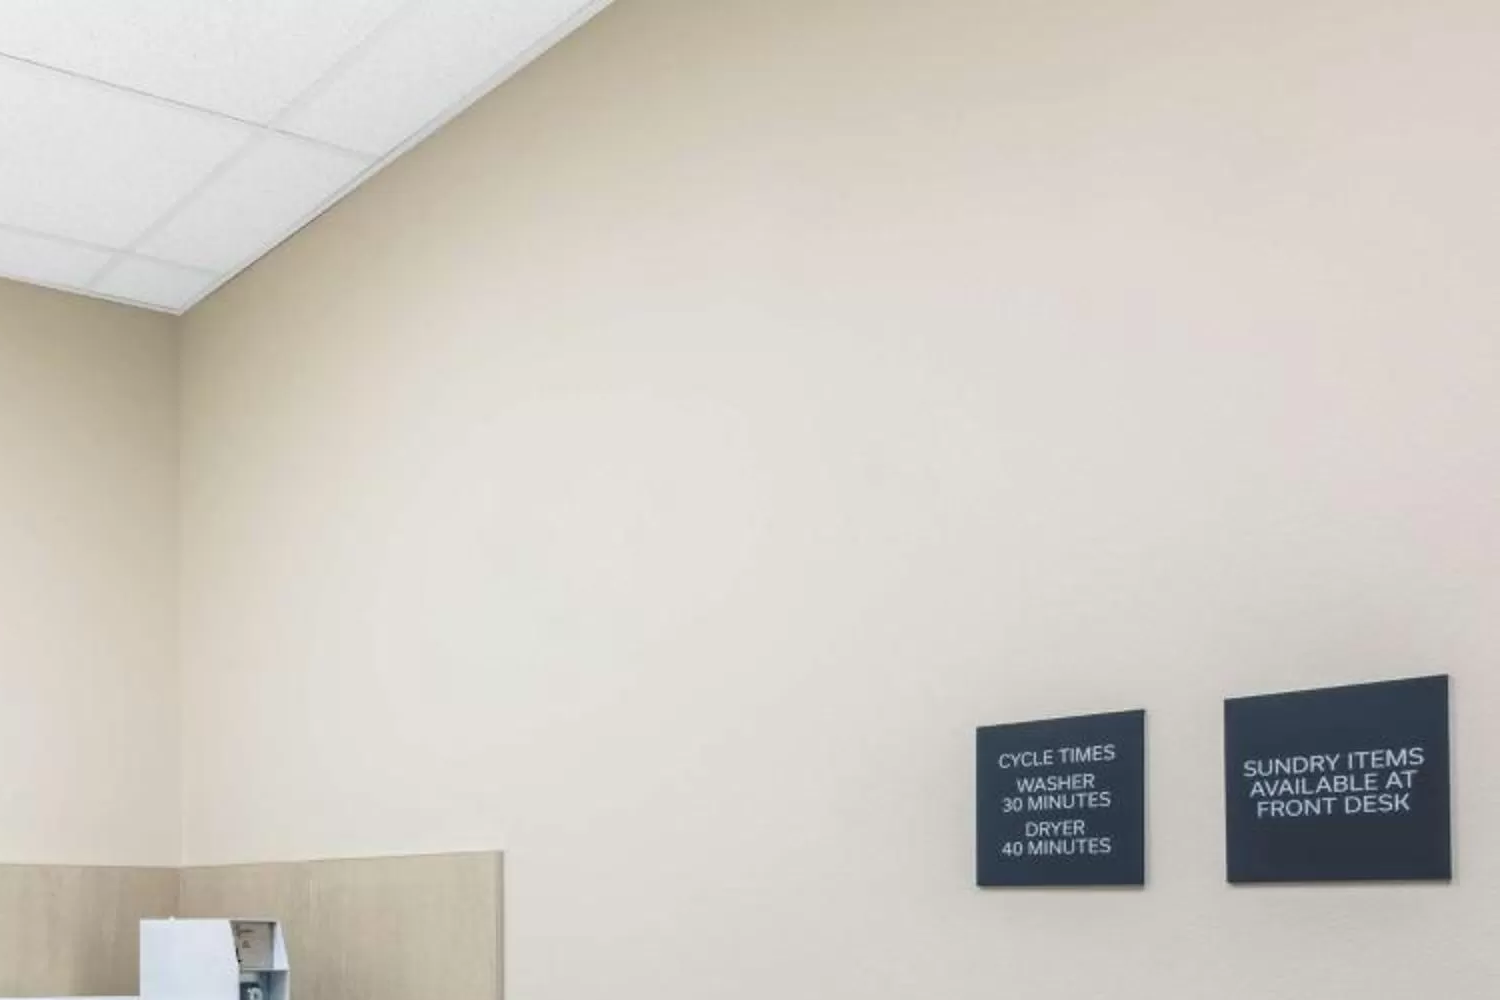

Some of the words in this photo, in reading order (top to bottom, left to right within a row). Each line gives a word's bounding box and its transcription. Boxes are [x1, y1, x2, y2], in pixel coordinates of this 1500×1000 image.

[999, 749, 1054, 769] CYCLE
[1058, 744, 1116, 764] TIMES
[1243, 753, 1340, 777] SUNDRY
[1348, 747, 1425, 769] ITEMS
[1016, 773, 1095, 793] WASHER
[1250, 773, 1379, 798] AVAILABLE
[1385, 769, 1419, 789] AT
[1003, 797, 1023, 813] 30
[1027, 791, 1112, 811] MINUTES
[1257, 797, 1337, 818] FRONT
[1345, 793, 1410, 814] DESK
[1025, 819, 1085, 837] DRYER
[1002, 841, 1023, 856] 40
[1027, 837, 1112, 856] MINUTES
